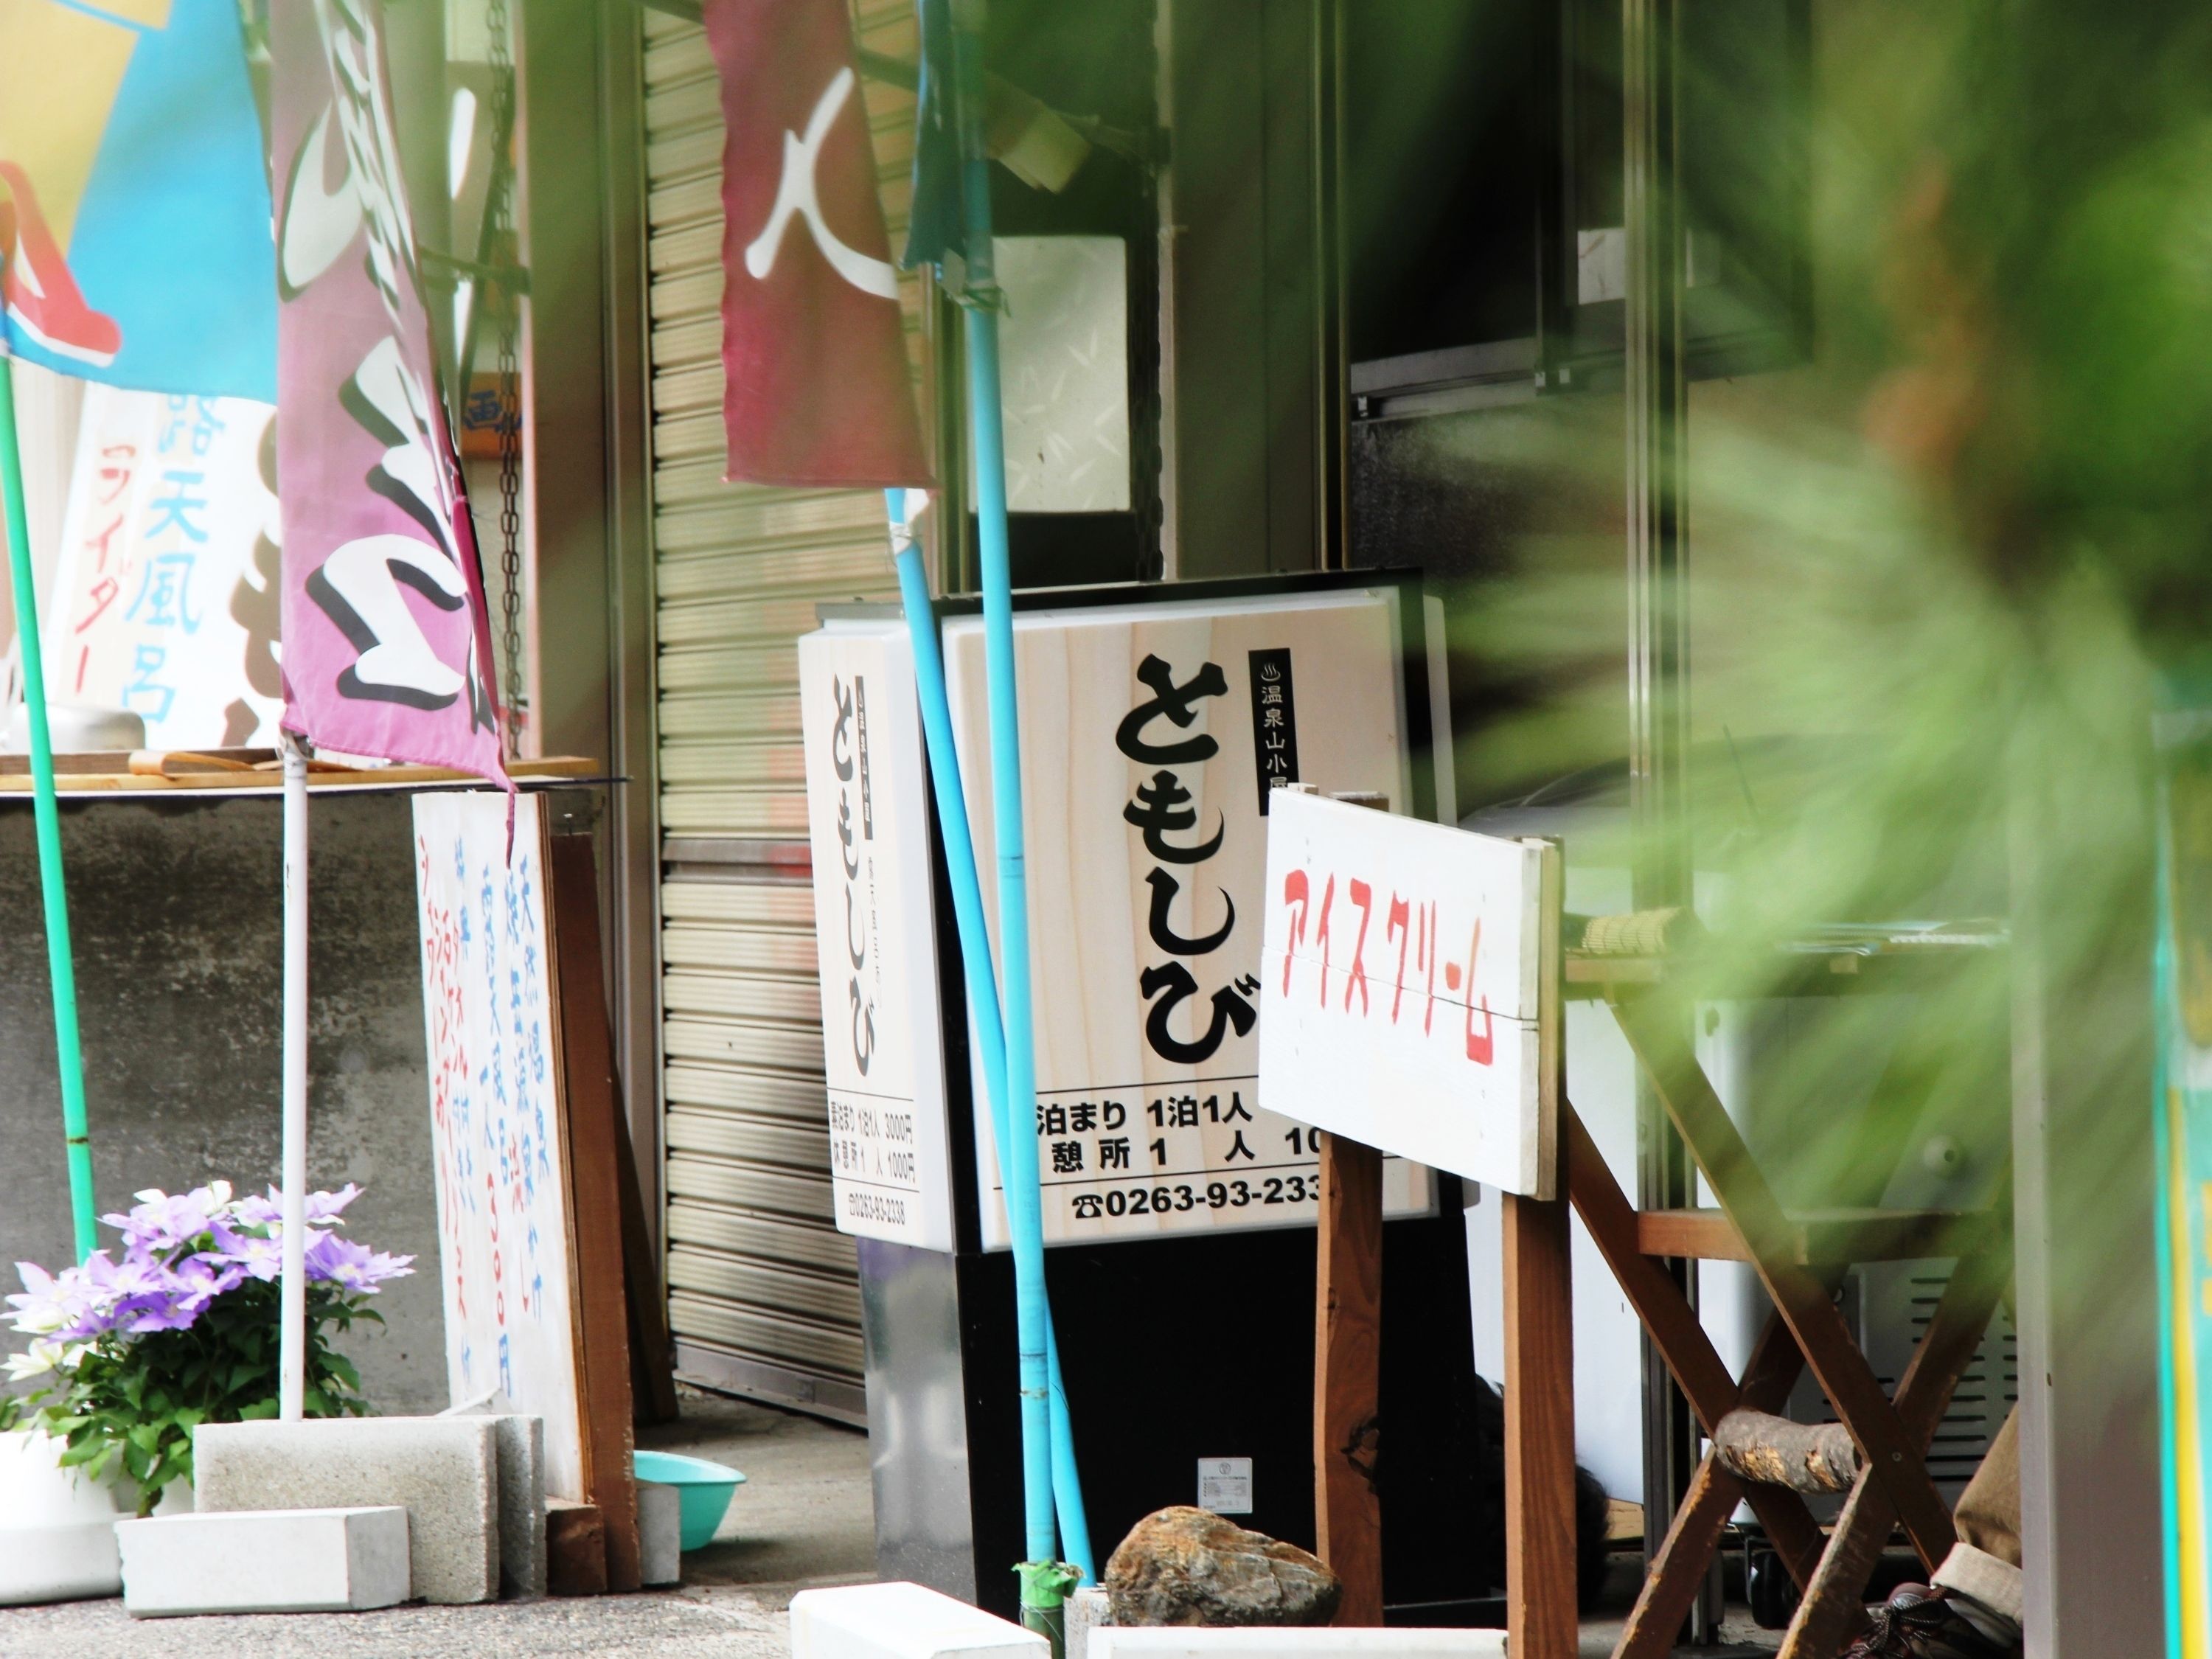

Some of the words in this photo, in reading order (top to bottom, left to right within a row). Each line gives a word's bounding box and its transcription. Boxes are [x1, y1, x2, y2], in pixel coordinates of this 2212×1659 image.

[832, 672, 875, 1077] ともしび
[1116, 653, 1262, 1064] ともしび
[1282, 869, 1495, 1067] アイスクリーム
